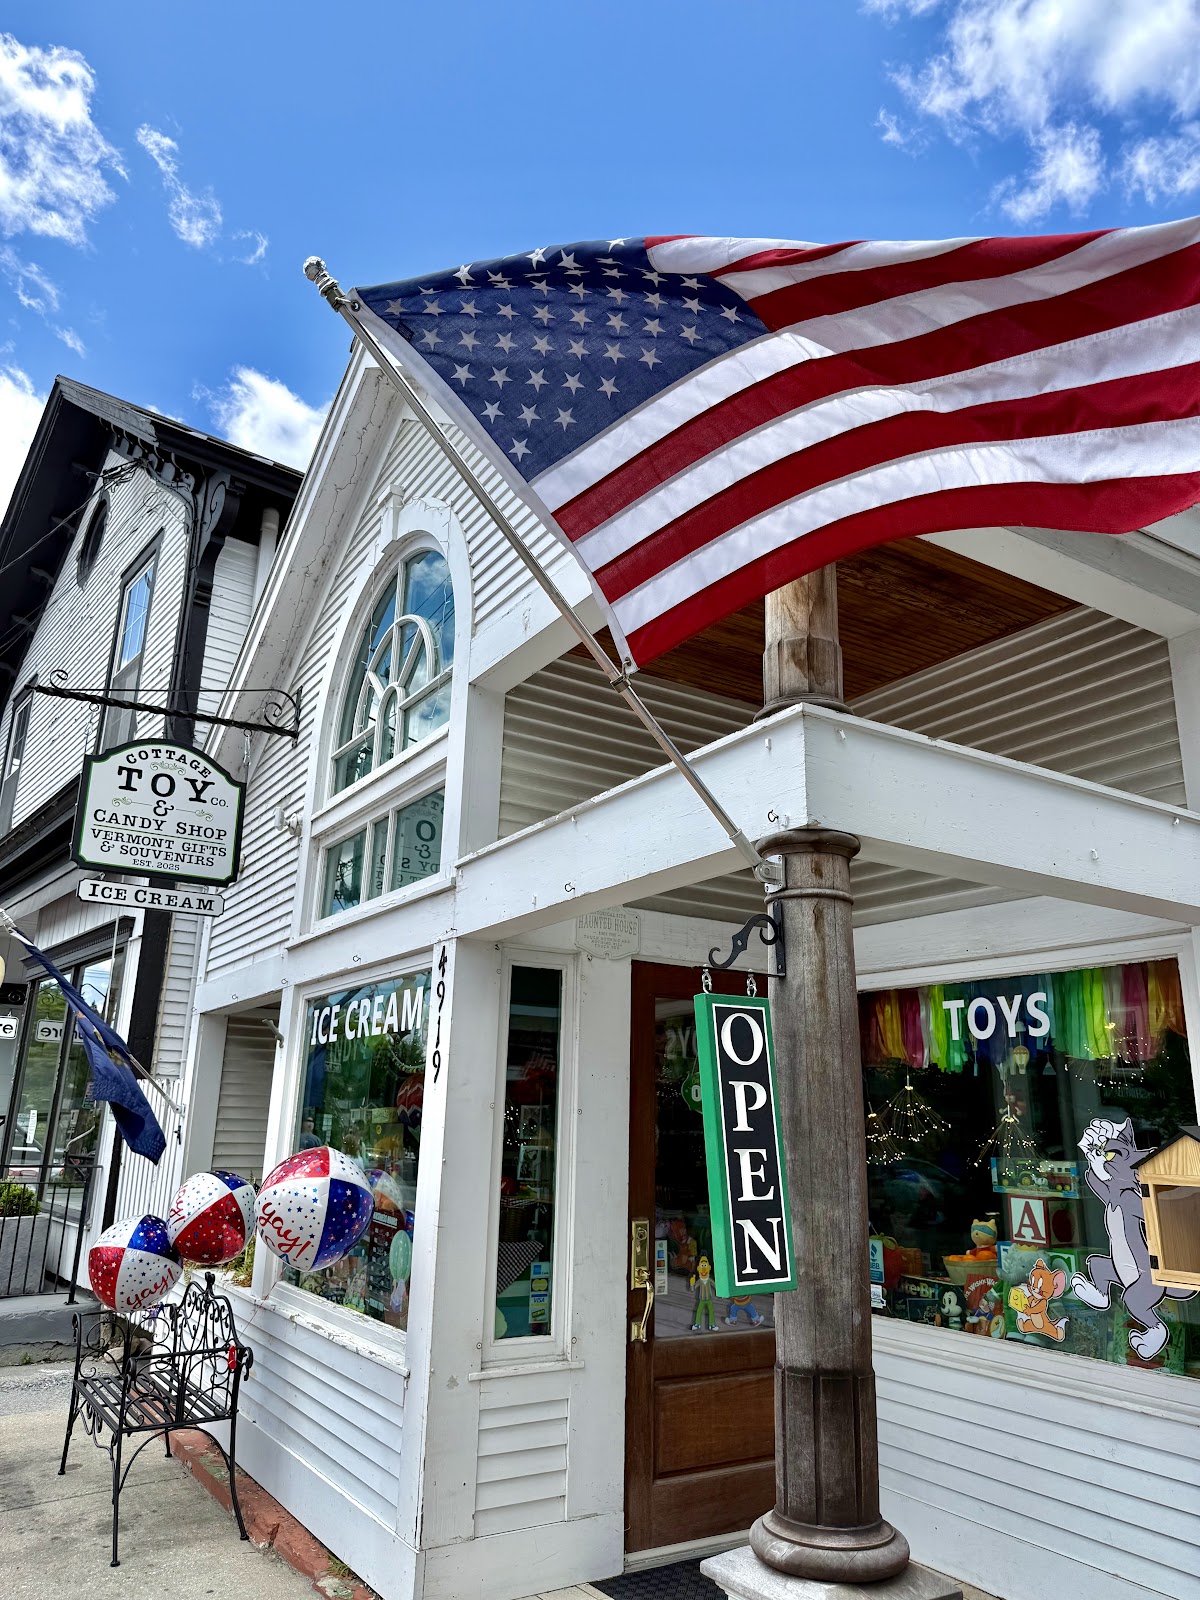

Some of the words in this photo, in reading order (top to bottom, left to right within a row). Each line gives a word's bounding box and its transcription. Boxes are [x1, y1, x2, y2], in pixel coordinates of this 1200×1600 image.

[126, 749, 211, 778] COTTAGE
[117, 766, 215, 804] TOY
[210, 797, 229, 808] CO.
[93, 809, 167, 831] CANDY
[176, 822, 227, 840] SHOP
[153, 800, 174, 817] &
[91, 828, 174, 849] VERMONT
[182, 842, 227, 857] GIFTS
[100, 841, 114, 852] &
[120, 846, 214, 867] SOUVENIRS
[133, 859, 154, 868] EST.
[156, 862, 180, 871] 2025
[88, 883, 127, 901] ICE
[134, 890, 215, 911] CREAM
[578, 915, 612, 930] HAUNTED
[614, 918, 637, 936] HOUSE
[310, 1004, 341, 1046] ICE
[344, 986, 424, 1041] CREAM
[432, 945, 448, 1083] 4919
[942, 991, 1050, 1041] TOYS
[720, 1012, 782, 1275] OPEN
[258, 1202, 313, 1262] yay!
[1015, 1201, 1045, 1241] A
[127, 1269, 174, 1308] yay!
